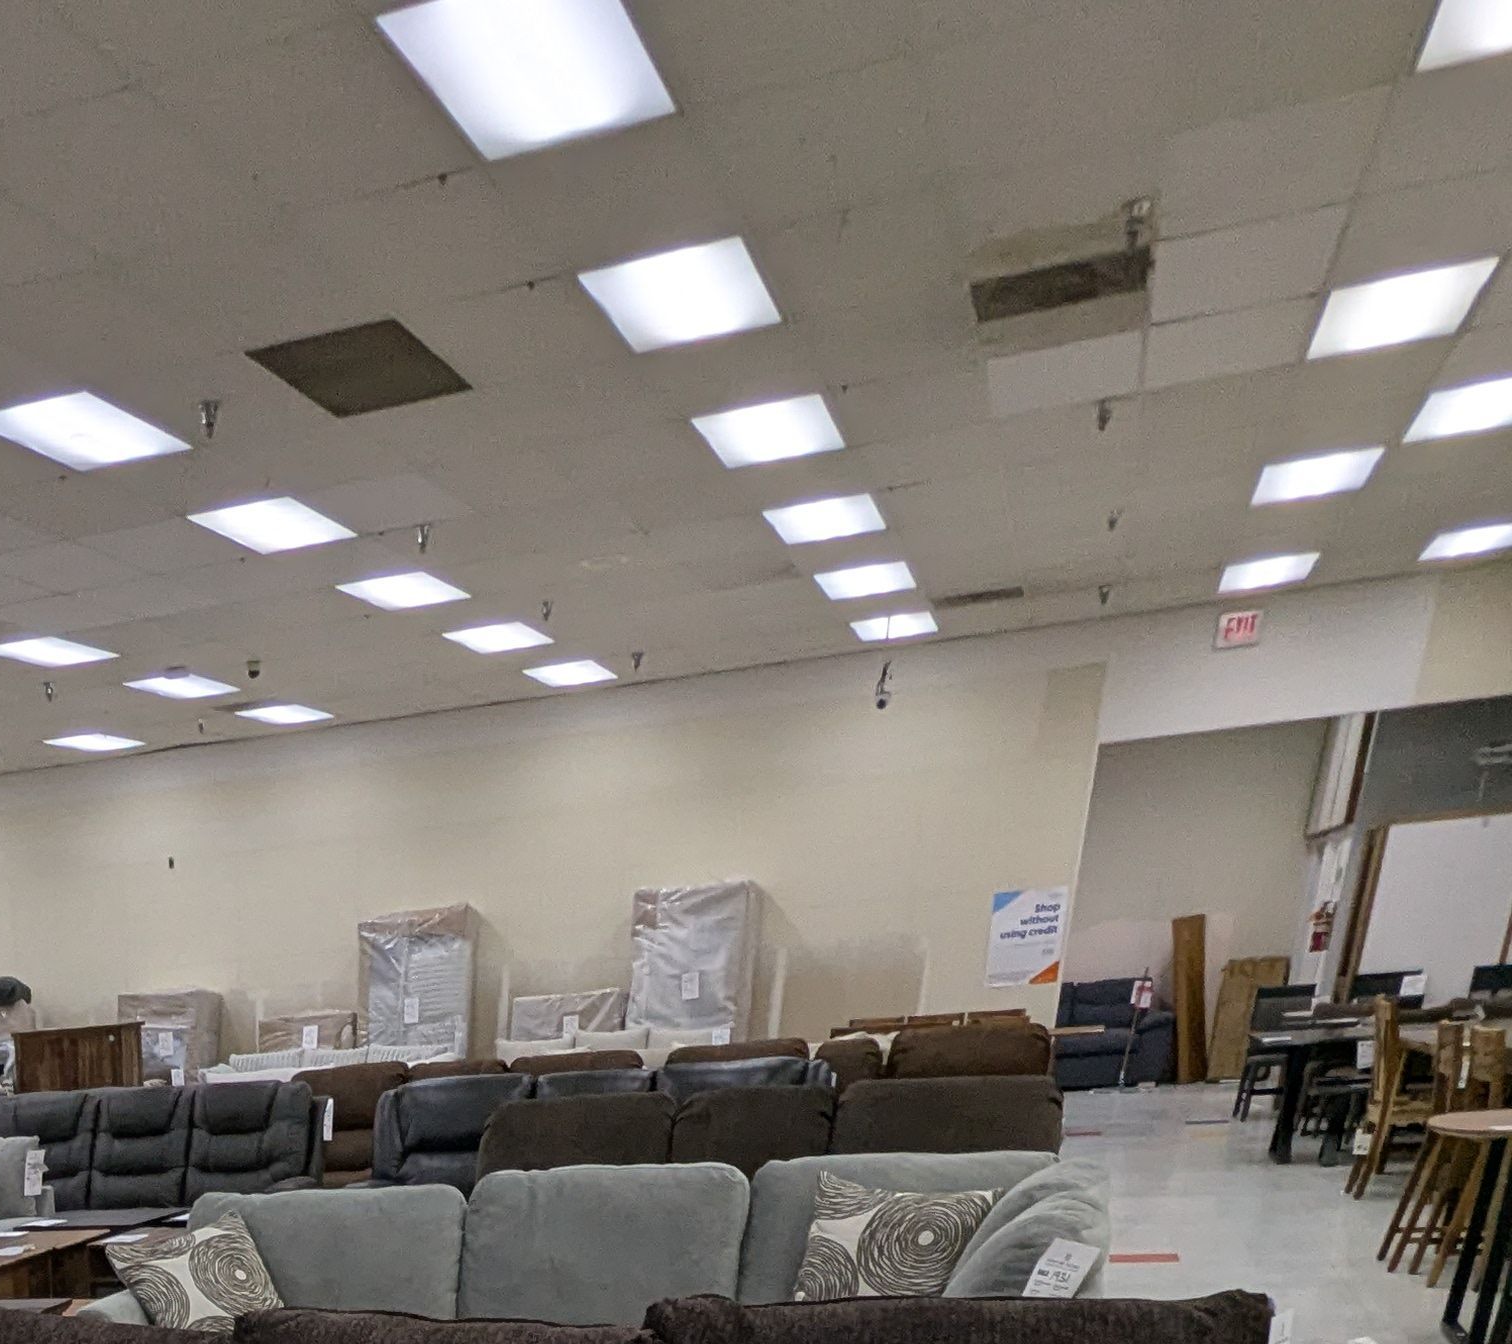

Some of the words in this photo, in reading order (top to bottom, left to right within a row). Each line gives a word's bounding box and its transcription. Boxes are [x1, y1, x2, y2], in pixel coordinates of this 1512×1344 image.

[1224, 614, 1257, 639] EXIT
[1035, 903, 1061, 913] Shop
[1020, 915, 1059, 925] without
[1000, 929, 1027, 939] using
[1028, 925, 1057, 936] credit
